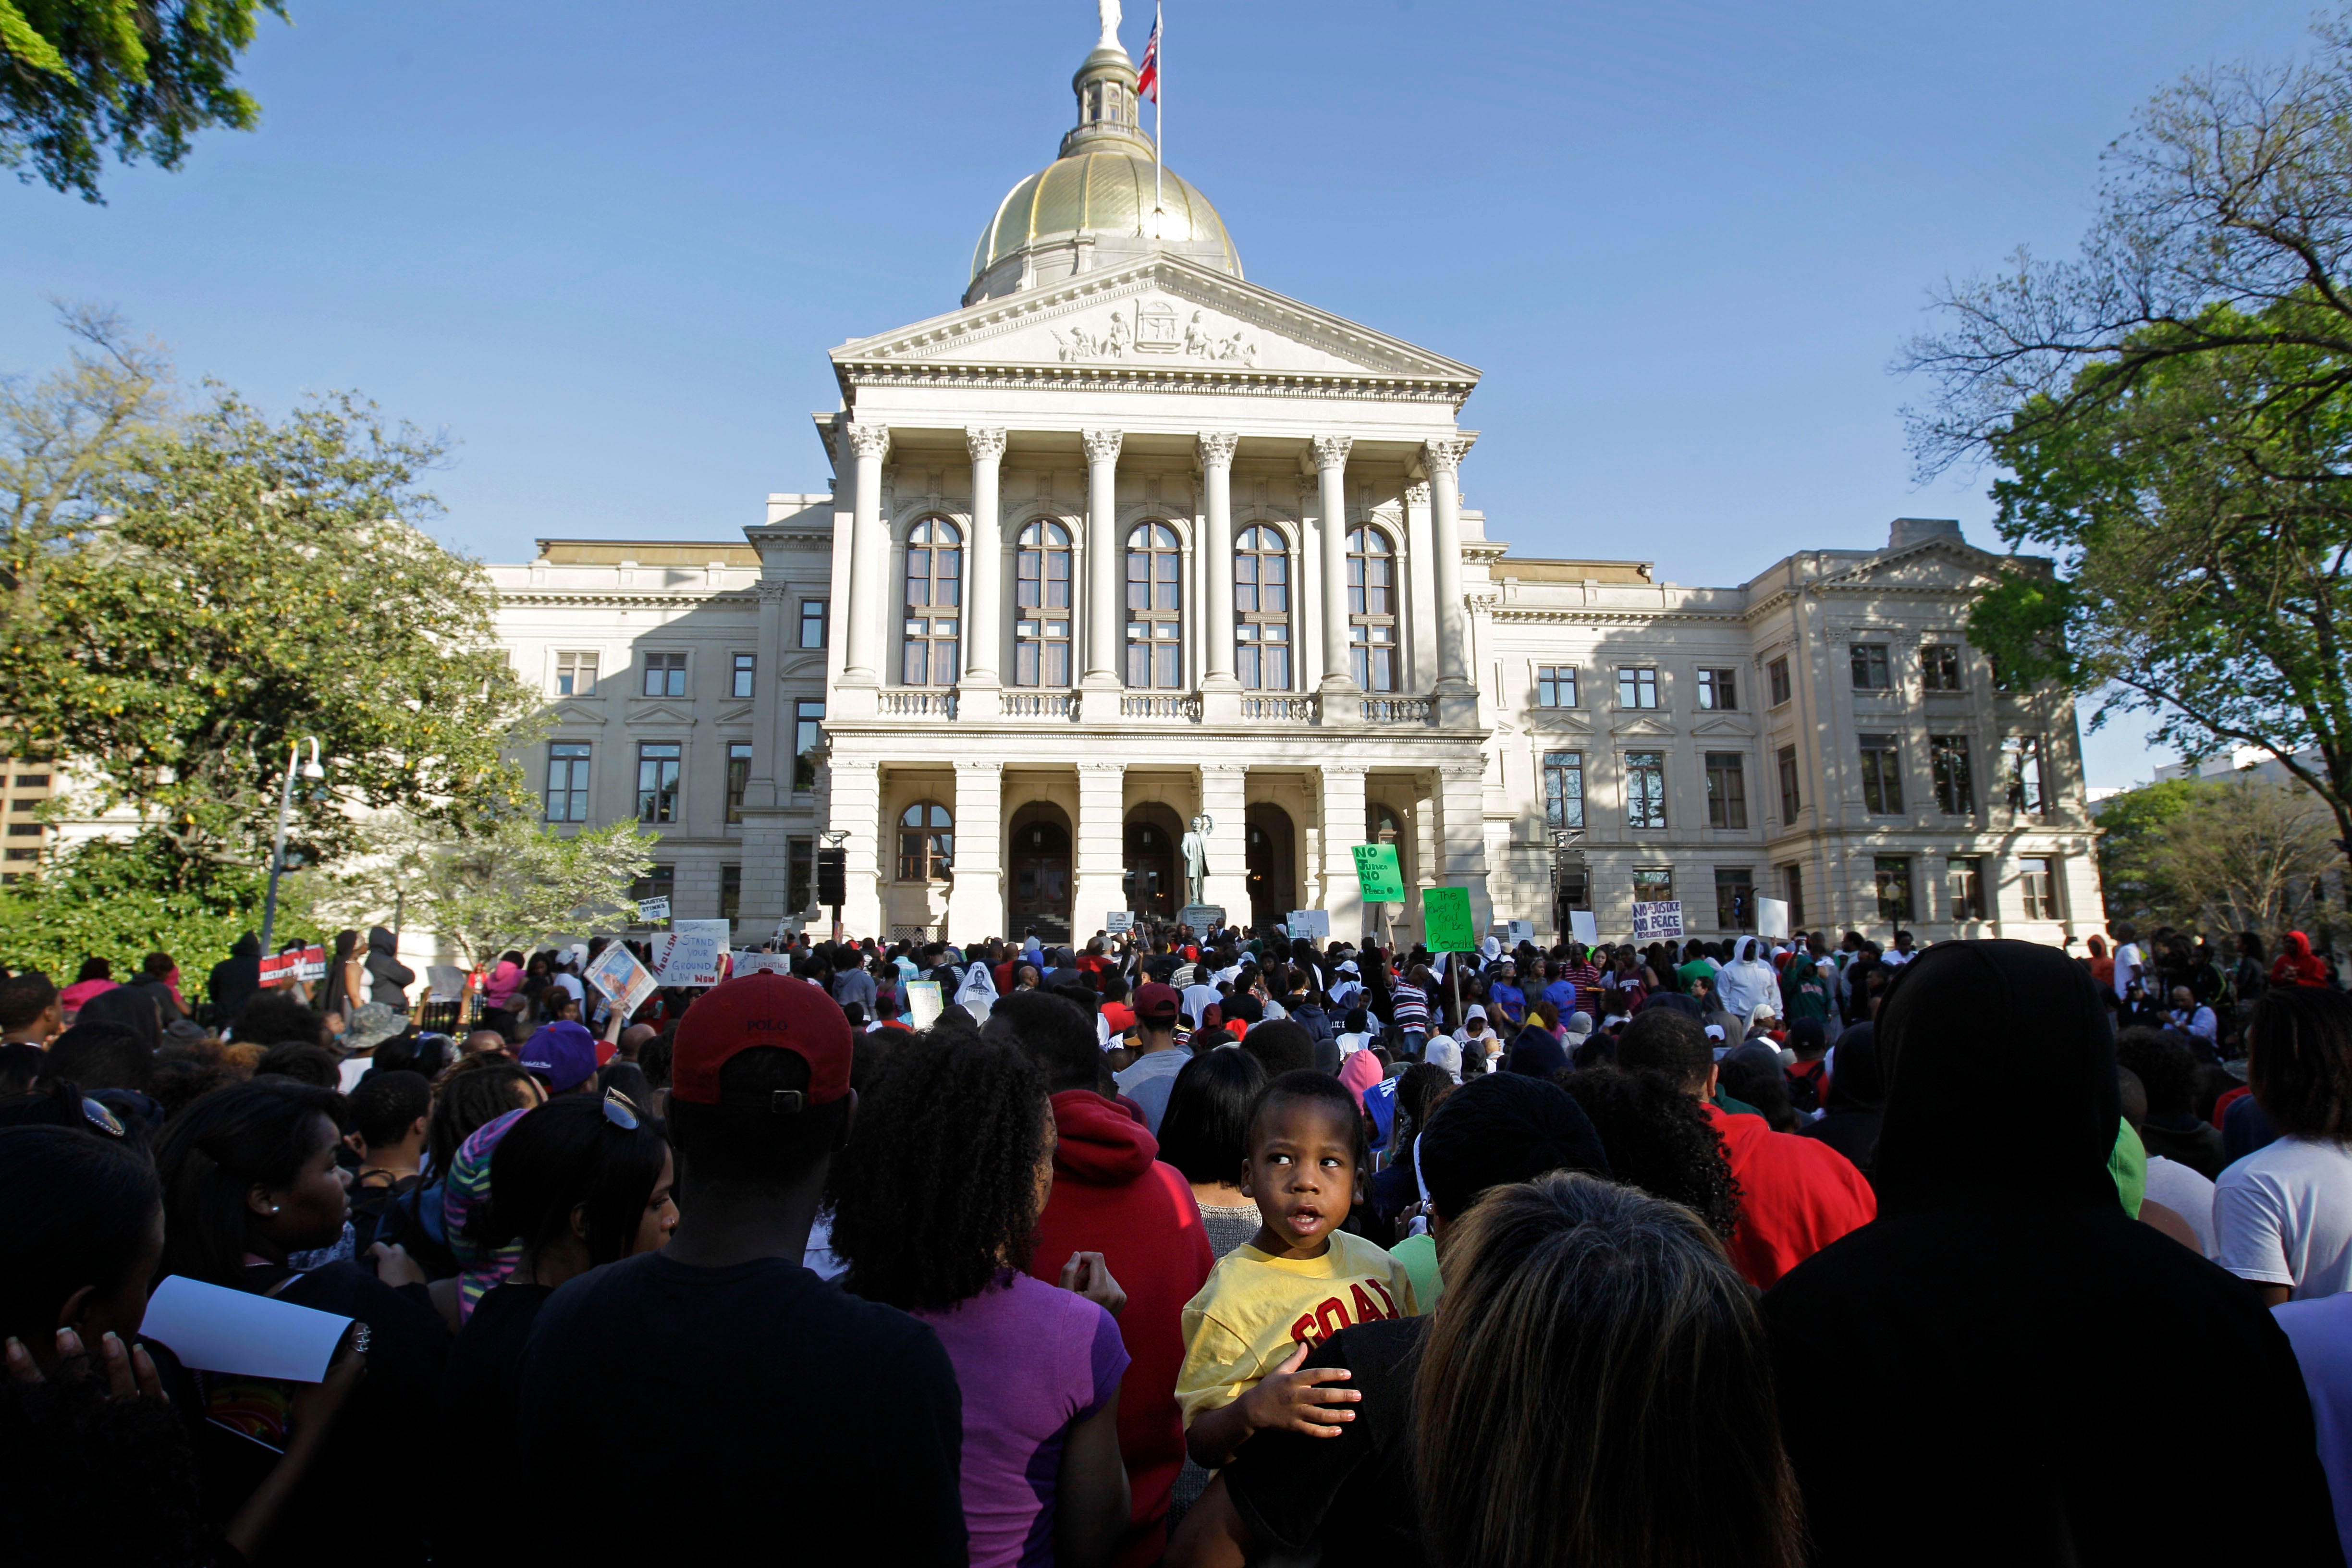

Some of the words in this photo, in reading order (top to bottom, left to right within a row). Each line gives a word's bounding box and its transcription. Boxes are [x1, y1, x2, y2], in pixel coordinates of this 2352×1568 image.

[1355, 847, 1377, 858] NO
[1360, 871, 1380, 881] NO
[1437, 891, 1458, 900] The
[642, 903, 665, 912] STINKS
[1426, 902, 1450, 914] Power
[1633, 904, 1647, 918] NO
[1651, 902, 1680, 915] JUSTICE
[1438, 912, 1458, 923] God
[1633, 918, 1648, 932] NO
[1651, 915, 1680, 929] PEACE
[680, 934, 714, 946] STAND
[687, 948, 708, 961] YOUR
[673, 961, 711, 970] GROUND
[671, 973, 690, 982] LAW
[695, 974, 715, 983] NOW
[747, 1020, 788, 1031] POLO
